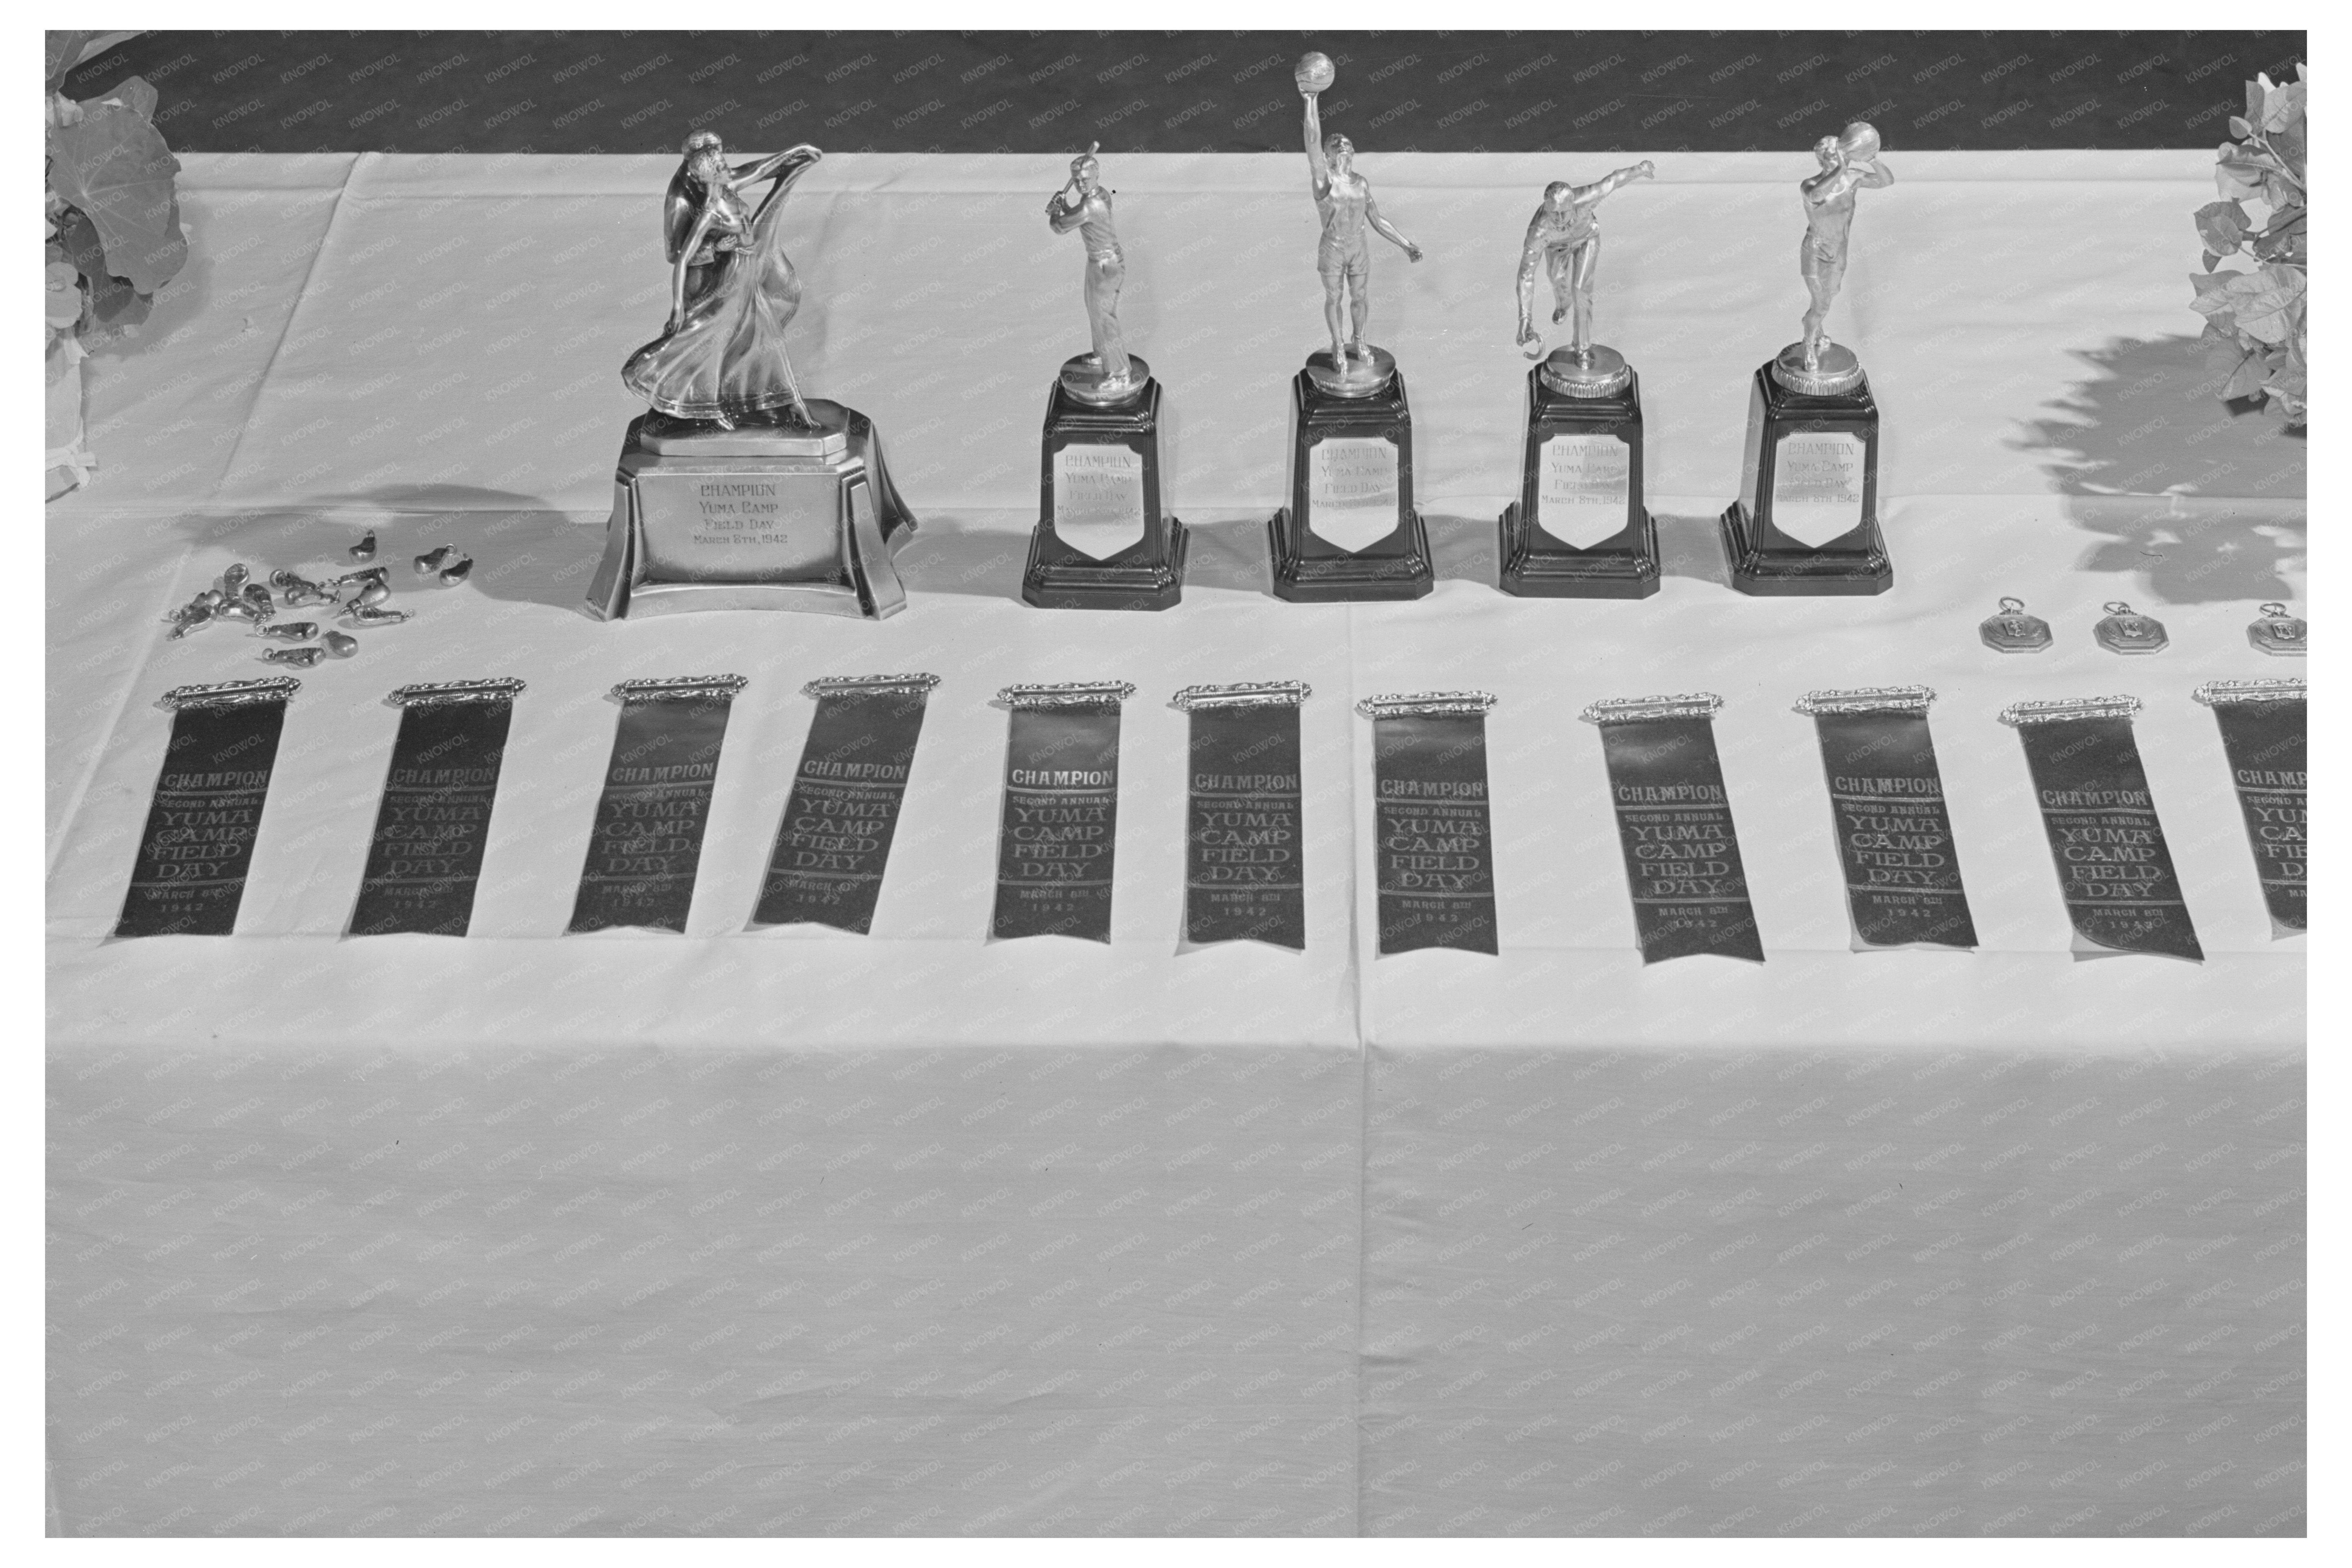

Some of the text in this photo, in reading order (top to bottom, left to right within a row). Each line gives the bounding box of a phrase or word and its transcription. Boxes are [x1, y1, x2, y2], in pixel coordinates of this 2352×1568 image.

[1788, 443, 1854, 455] CHAMPION
[701, 484, 776, 496] CHAMPION
[1541, 495, 1574, 503] MARCH
[699, 501, 778, 513] YUMA CAMP
[704, 519, 774, 530] FIELD DAY
[694, 535, 729, 543] MARCH
[393, 767, 496, 784] CHAMPION
[612, 762, 714, 782] CHAMPION
[804, 760, 906, 780] CHAMPION
[1012, 769, 1114, 786] CHAMPION
[164, 770, 268, 788] CHAMPION
[1195, 773, 1298, 790] CHAMPION
[1835, 777, 1940, 793] CHAMPION
[1381, 779, 1484, 797] CHAMPION
[1618, 785, 1723, 802] CHAMPION
[161, 799, 205, 808] SECOND
[1012, 796, 1109, 805] SECOND ANNUAL
[2042, 790, 2149, 806] CHAMPION
[390, 806, 483, 821] YUMA
[610, 801, 699, 819] YUMA
[800, 798, 890, 817] YUMA
[1246, 802, 1294, 810] ANNUAL
[1384, 807, 1481, 817] SECOND ANNUAL
[1841, 804, 1940, 814] SECOND ANNUAL
[162, 809, 253, 826] YUMA
[1015, 808, 1107, 823] YUMA
[1200, 812, 1294, 827] YUMA
[1675, 813, 1724, 821] ANNUAL
[2101, 817, 2150, 826] ANNUAL
[606, 820, 695, 837] CAMP
[795, 817, 885, 834] CAMP
[1388, 818, 1481, 834] YUMA
[1846, 815, 1942, 832] YUMA
[156, 826, 251, 843] CAMP
[1013, 826, 1104, 841] CAMP
[1200, 830, 1291, 845] CAMP
[1630, 824, 1726, 840] YUMA
[2057, 828, 2156, 844] YUMA
[1388, 837, 1480, 853] CAMP
[1850, 833, 1943, 849] CAMP
[151, 844, 242, 860] FIELD
[1013, 844, 1102, 859] FIELD
[1201, 848, 1290, 862] FIELD
[1635, 843, 1727, 859] CAMP
[2064, 846, 2156, 862] CAMP
[390, 858, 463, 873] DAY
[607, 855, 677, 872] DAY
[794, 851, 865, 870] DAY
[1390, 855, 1480, 871] FIELD
[1854, 851, 1945, 867] FIELD
[156, 862, 229, 878] DAY
[1022, 862, 1091, 877] DAY
[1209, 866, 1283, 880] DAY
[1639, 861, 1730, 876] FIELD
[2069, 865, 2160, 879] FIELD
[1400, 873, 1471, 889] DAY
[1866, 869, 1937, 884] DAY
[1653, 880, 1722, 894] DAY
[2083, 883, 2154, 897] DAY
[1402, 900, 1445, 909] MARCH
[1872, 895, 1915, 904] MARCH
[1659, 907, 1701, 916] MARCH
[1888, 909, 1931, 917] 1942
